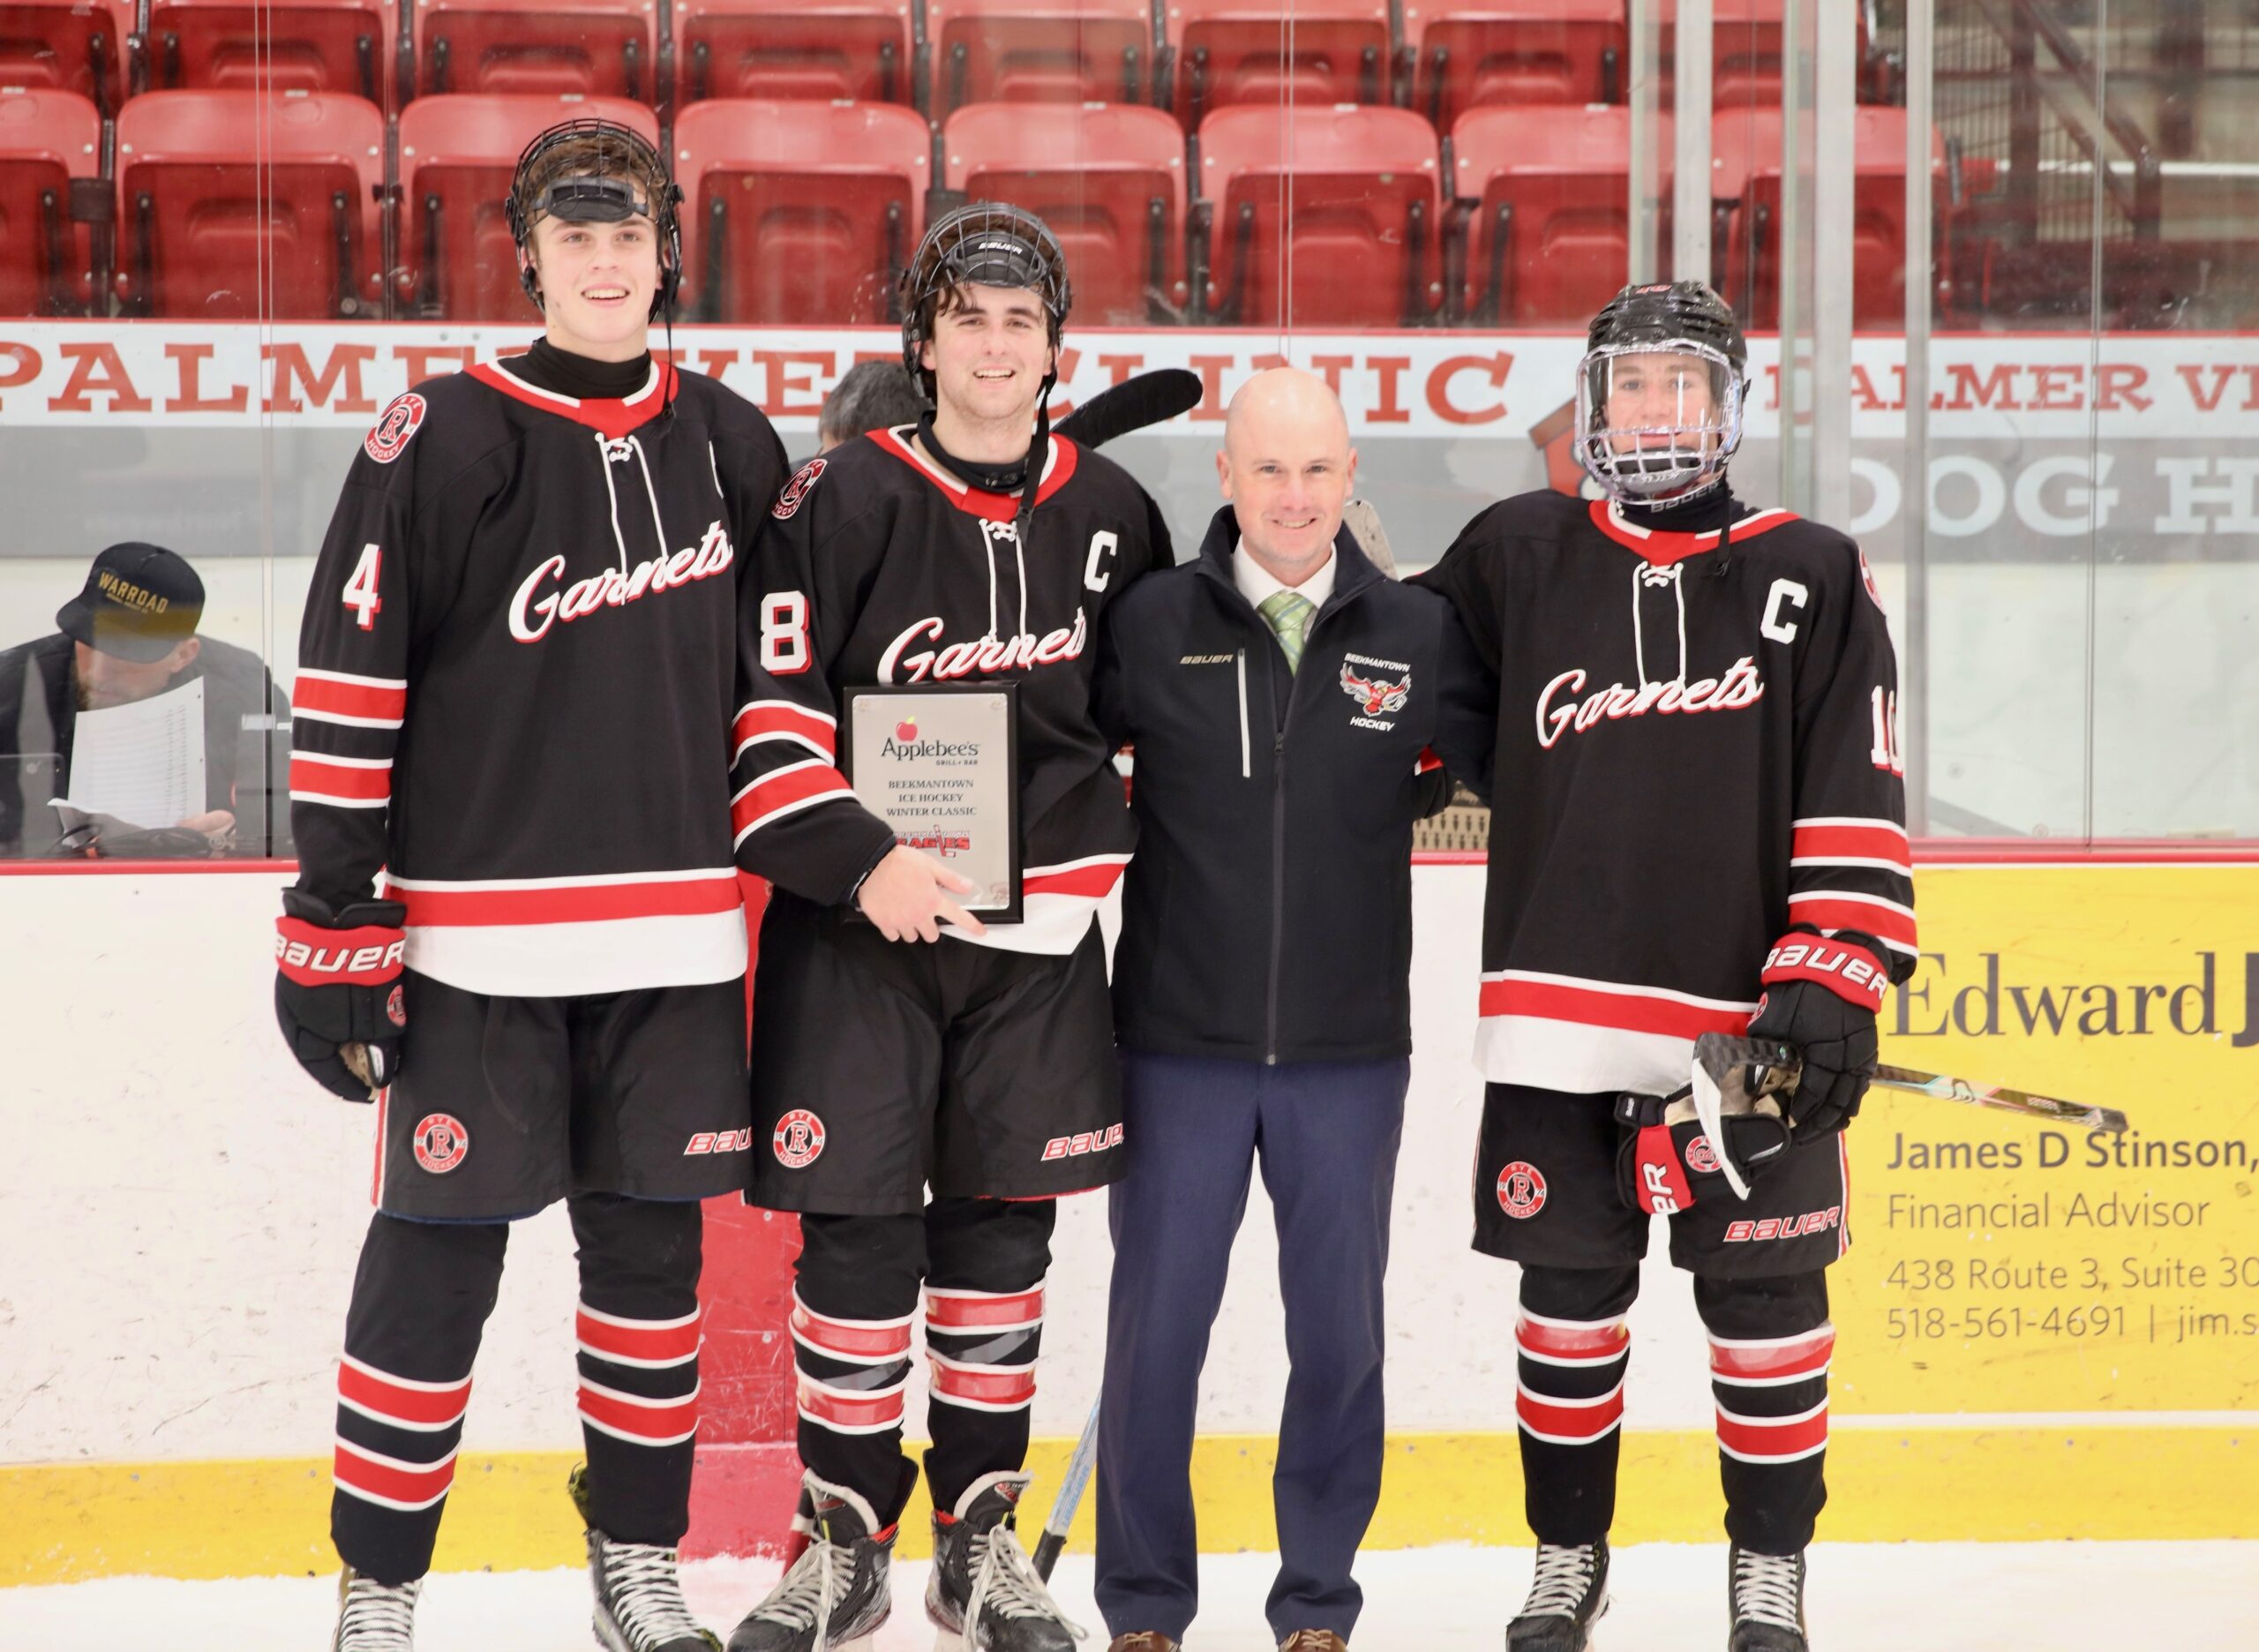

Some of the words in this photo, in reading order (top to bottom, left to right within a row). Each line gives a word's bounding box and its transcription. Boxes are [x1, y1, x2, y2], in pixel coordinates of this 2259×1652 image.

[1084, 529, 1118, 592] C
[98, 572, 169, 614] WARROAD
[342, 543, 382, 632] 4
[508, 519, 734, 643] Garnets
[1760, 578, 1808, 644] C
[760, 590, 812, 676] 8
[1179, 654, 1234, 665] BAUER
[1343, 652, 1411, 672] BEEKMANTOWN
[1535, 656, 1765, 749] Garnets
[1349, 716, 1395, 732] HOCKEY
[881, 736, 979, 762] Applebee's
[888, 779, 974, 790] BEEKMANTOWN
[898, 793, 918, 803] ICE
[919, 792, 964, 803] HOCKEY
[886, 807, 929, 817] WINTER
[931, 807, 978, 816] CLASSIC
[1886, 950, 2223, 1037] Edward
[1040, 1123, 1125, 1162] BAUE
[1887, 1131, 2023, 1170] James
[2038, 1131, 2070, 1168] D
[2085, 1130, 2259, 1174] Stinson,
[1722, 1205, 1841, 1243] BAUER
[1888, 1191, 2049, 1229] Financial
[2064, 1190, 2210, 1228] Advisor
[1886, 1258, 1955, 1292] 438
[1968, 1258, 2068, 1290] Route
[2080, 1258, 2109, 1294] 3,
[2120, 1257, 2207, 1288] Suite
[1887, 1305, 2125, 1340] 518-561-4691
